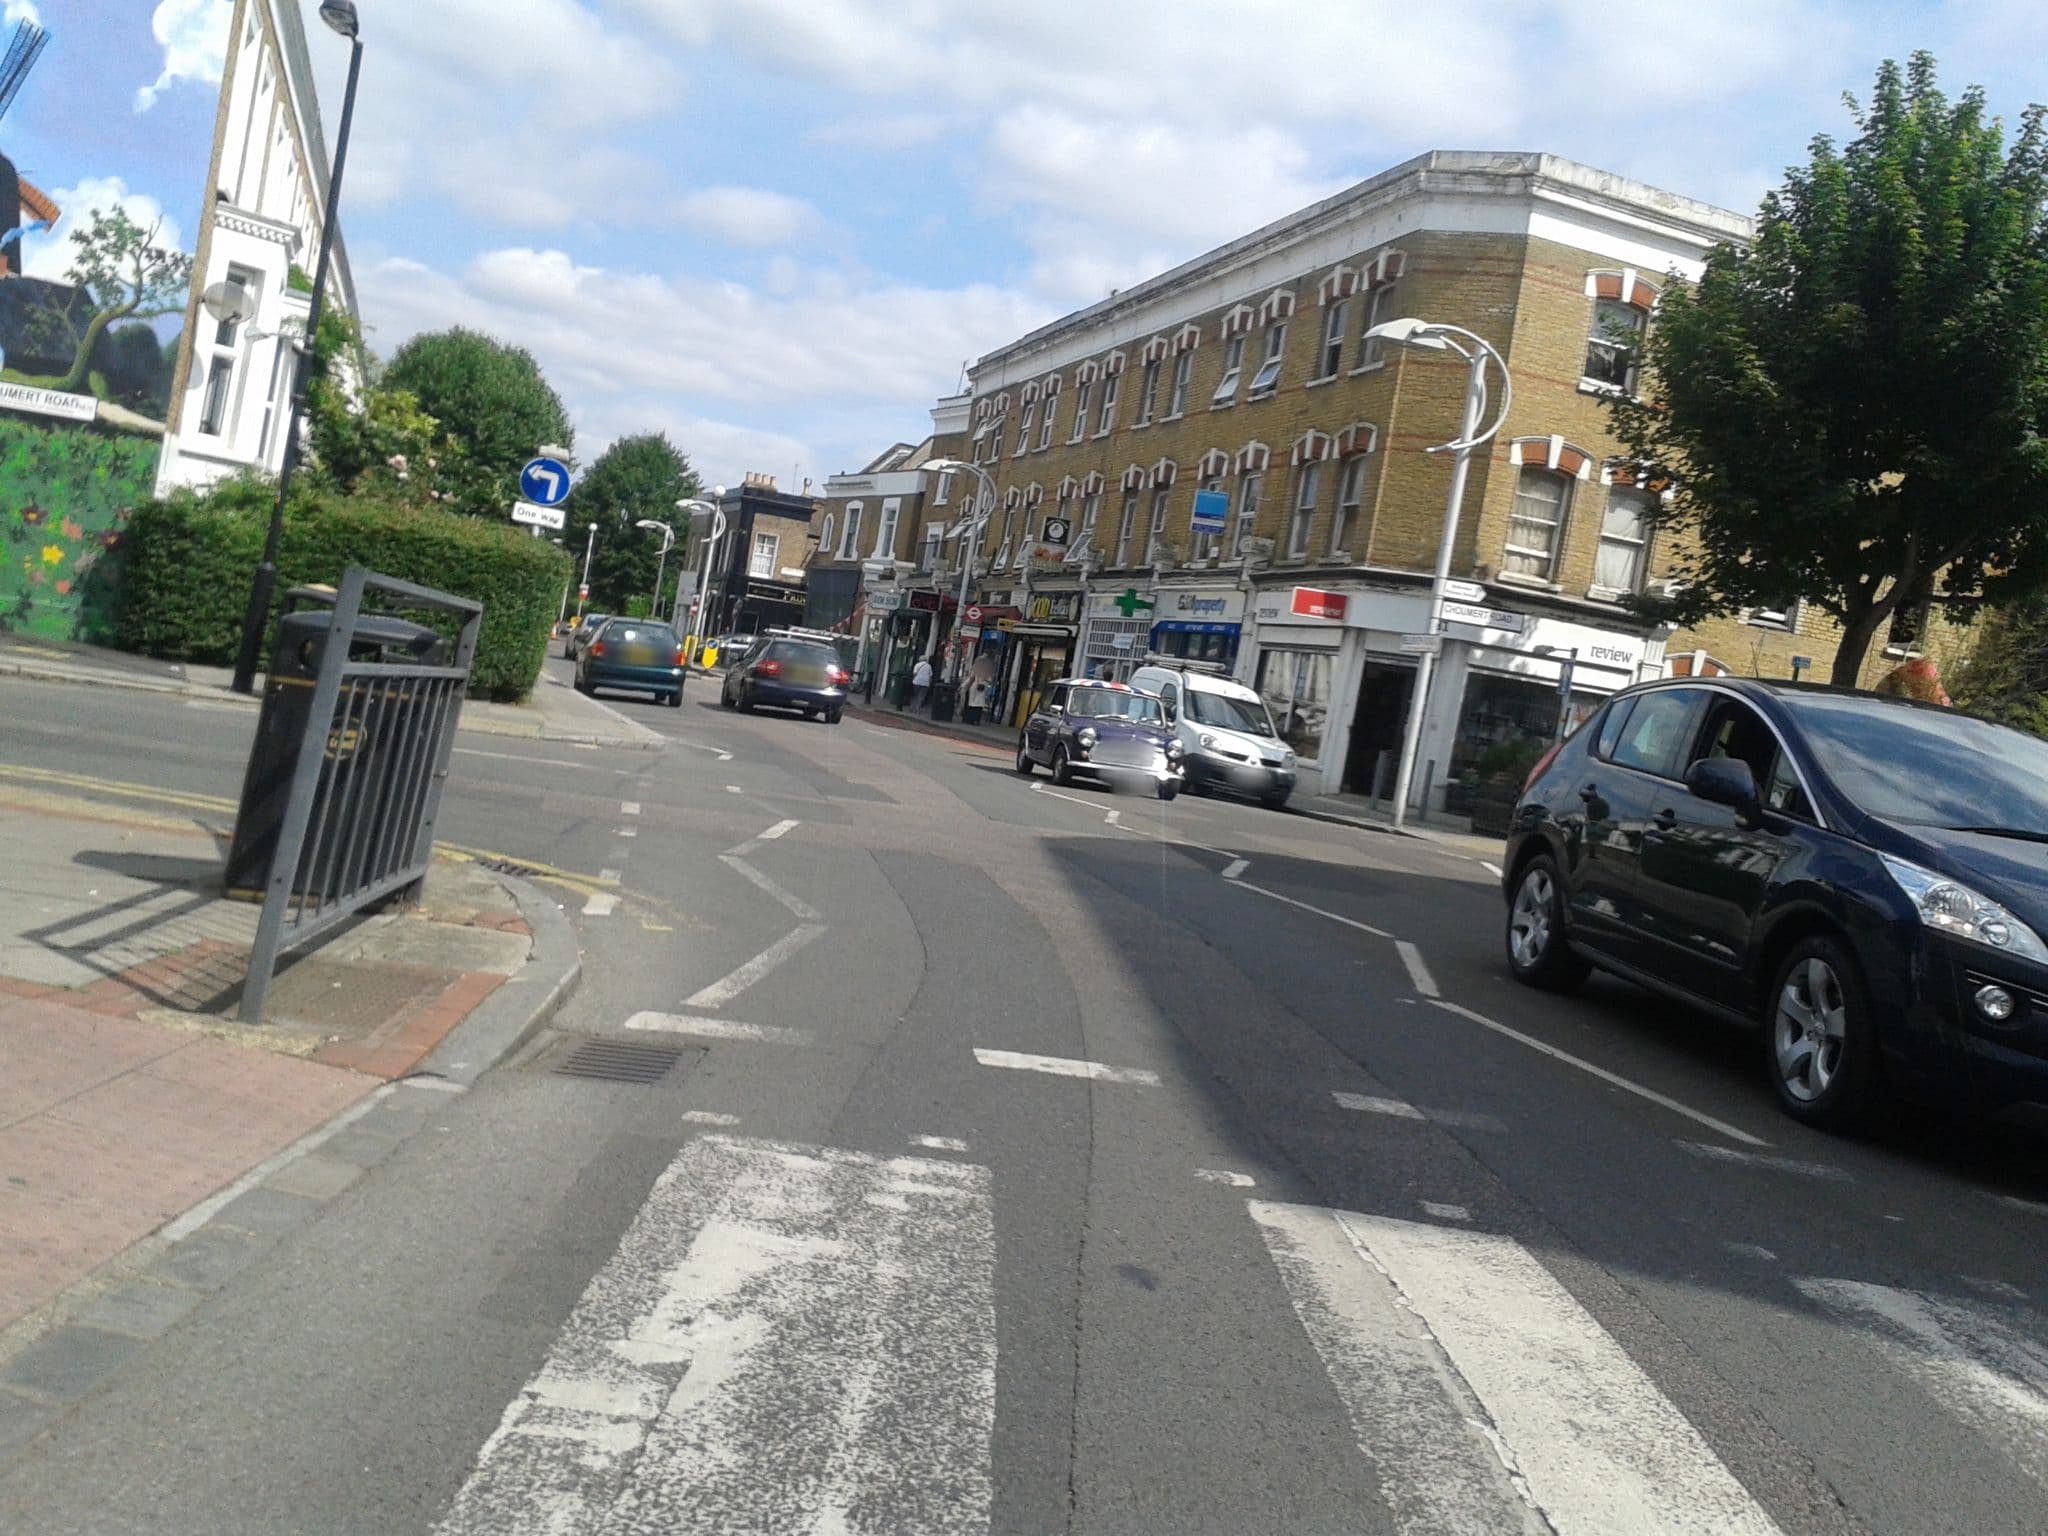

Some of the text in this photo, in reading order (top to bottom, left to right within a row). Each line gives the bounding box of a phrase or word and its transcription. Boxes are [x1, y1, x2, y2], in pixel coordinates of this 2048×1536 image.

[44, 394, 80, 409] ROAD
[517, 507, 537, 518] One
[1444, 604, 1513, 624] CHOUMERT ROAD
[1591, 645, 1633, 663] review
